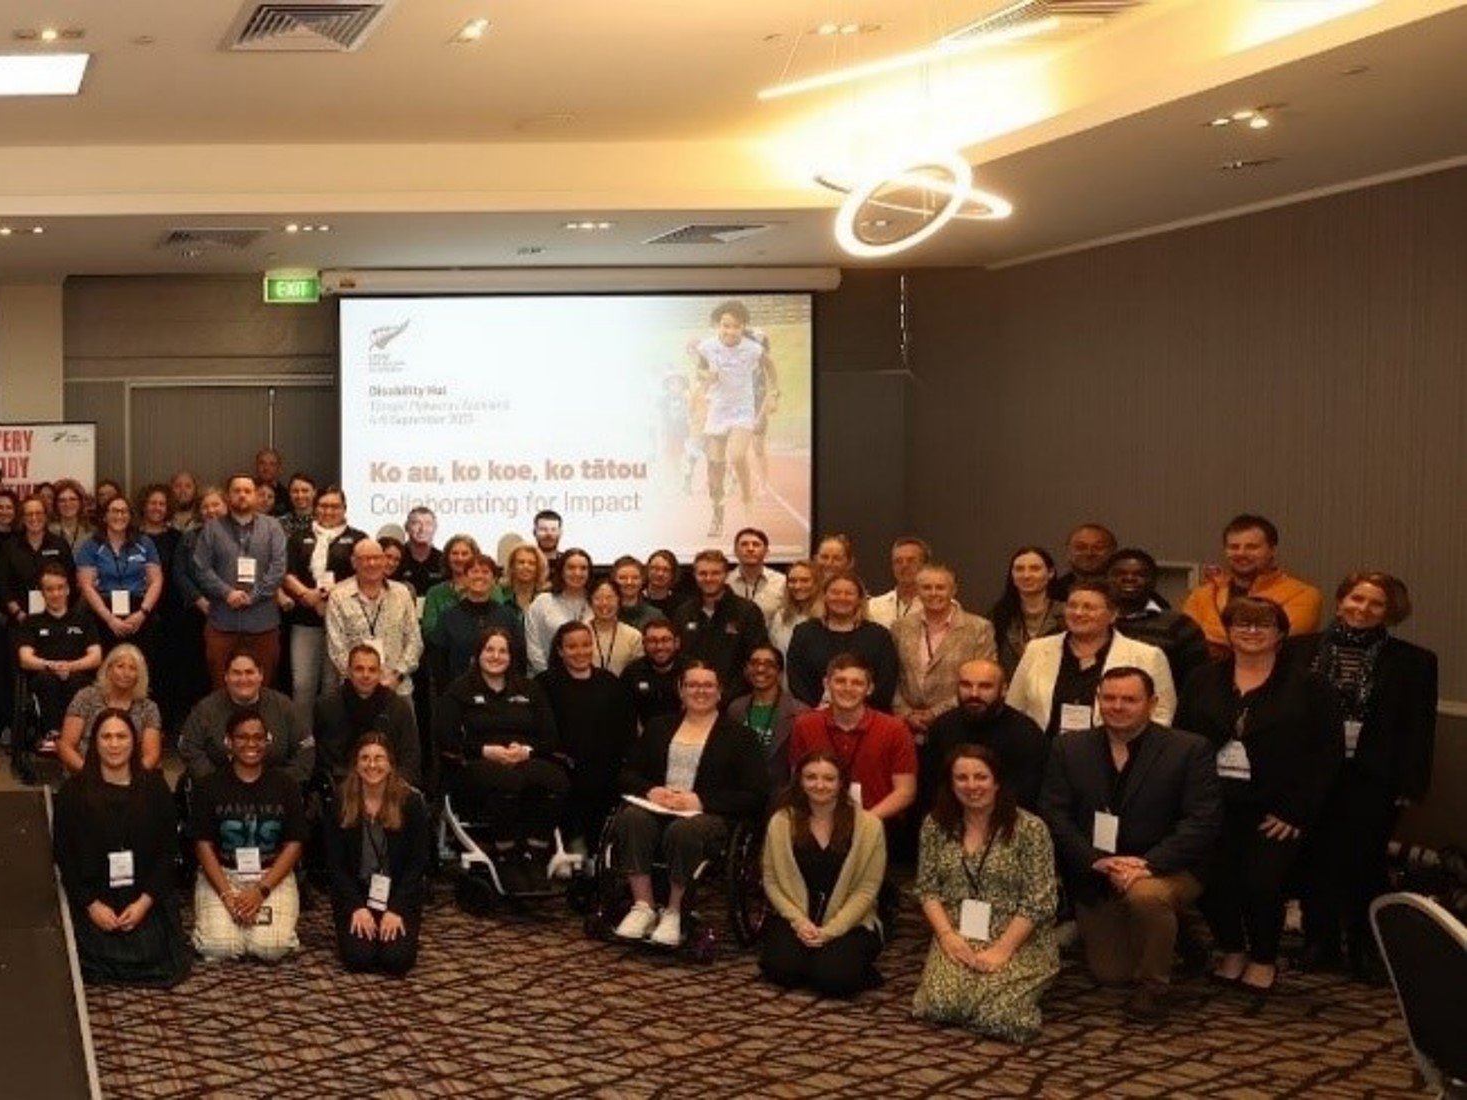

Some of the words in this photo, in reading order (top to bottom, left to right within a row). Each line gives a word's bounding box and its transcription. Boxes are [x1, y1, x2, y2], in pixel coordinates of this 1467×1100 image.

[275, 281, 309, 297] EXIT
[370, 462, 402, 483] Ko
[407, 465, 445, 485] au,
[452, 460, 482, 482] ko
[488, 460, 538, 484] koe,
[545, 459, 575, 481] ko
[581, 458, 647, 481] tātou
[370, 490, 519, 519] Collaborating
[526, 491, 558, 513] for
[564, 490, 641, 519] Impact
